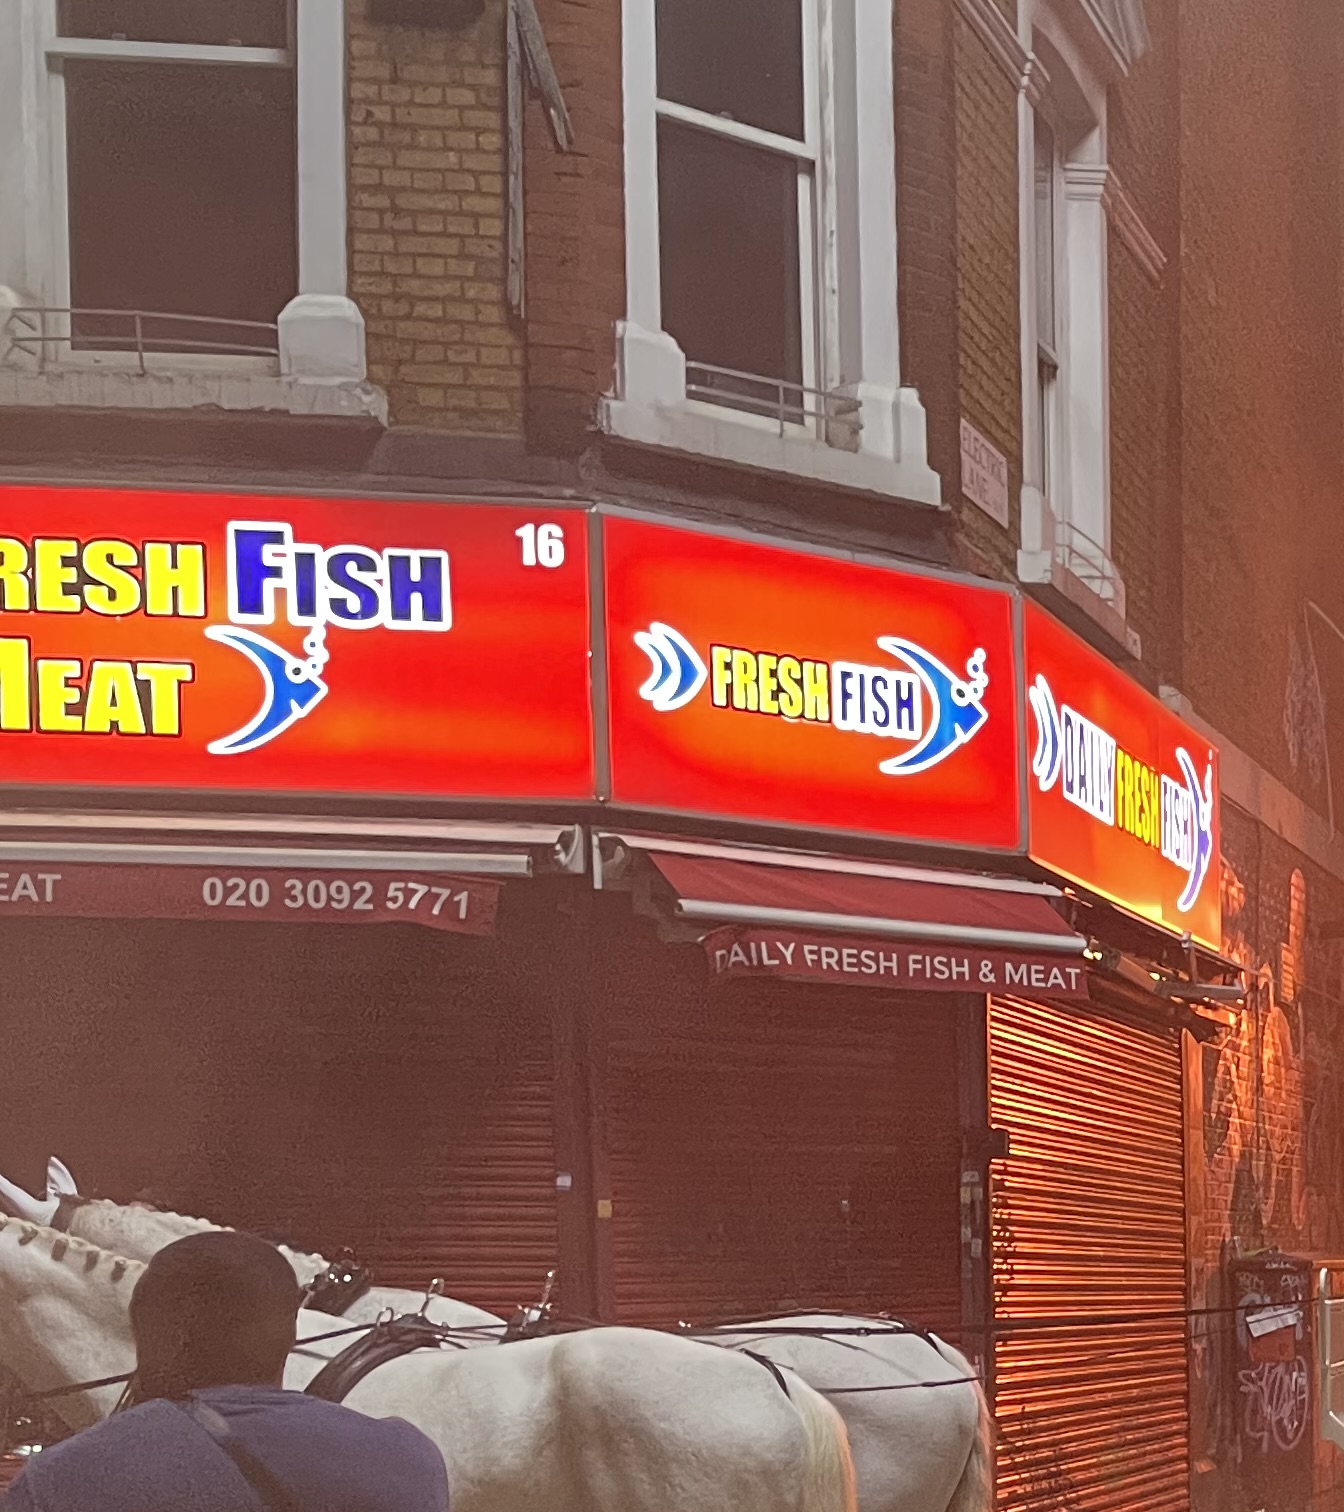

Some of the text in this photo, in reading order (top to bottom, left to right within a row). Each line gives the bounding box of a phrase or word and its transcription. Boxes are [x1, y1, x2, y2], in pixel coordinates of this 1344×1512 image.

[0, 523, 451, 630] RESH FISH
[515, 523, 565, 567] 16
[711, 645, 916, 733] FRESH FISH
[1064, 711, 1193, 866] DAILY FRESH FISH
[202, 876, 270, 908] 020
[283, 878, 374, 911] 3092
[385, 881, 469, 920] 5771
[715, 941, 1081, 990] DAILY FRESH FISH & MEAT
